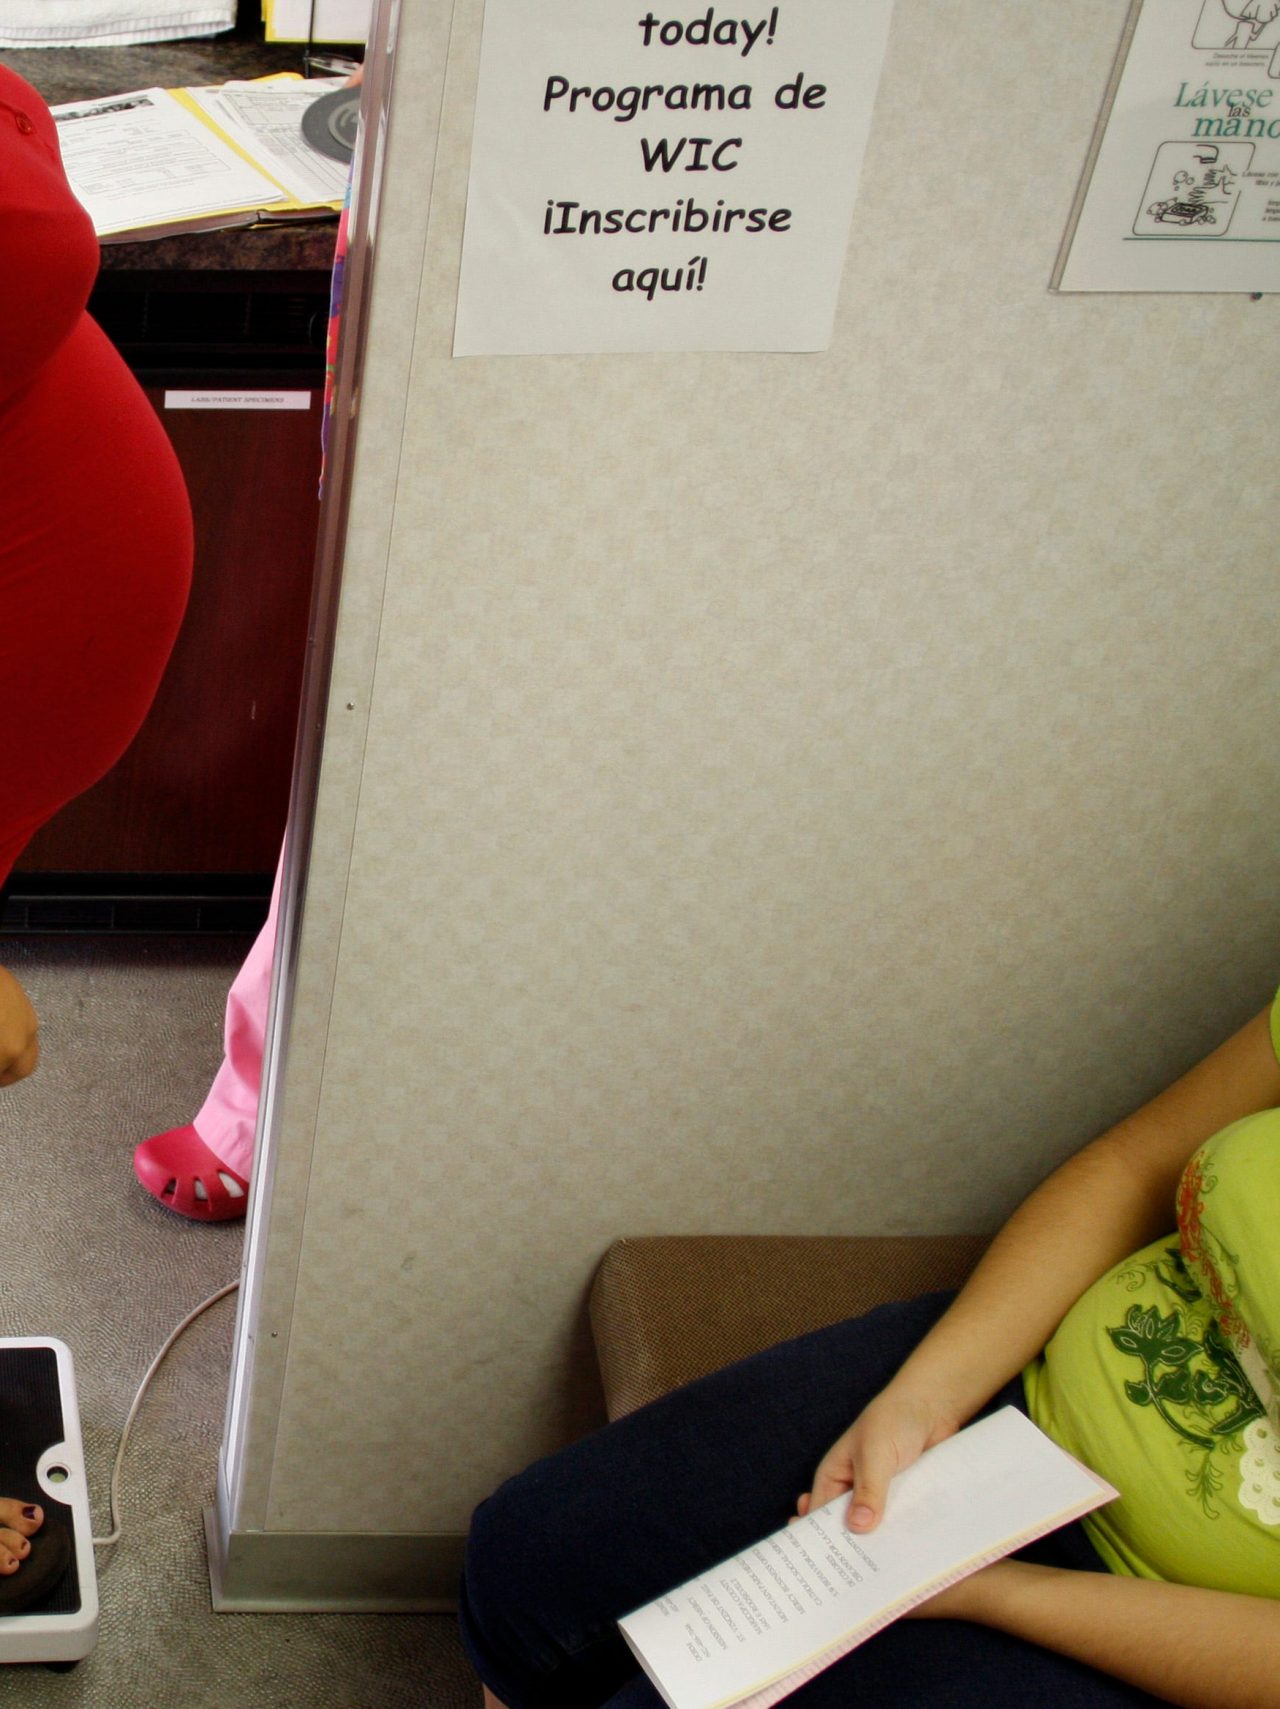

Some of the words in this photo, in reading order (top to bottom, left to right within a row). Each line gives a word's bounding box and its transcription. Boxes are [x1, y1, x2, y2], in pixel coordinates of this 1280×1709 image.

[639, 7, 778, 57] today!
[543, 75, 752, 122] Programa
[774, 72, 827, 109] de
[1174, 81, 1273, 108] Lávese
[1227, 103, 1251, 117] las
[641, 138, 742, 172] WIC
[612, 256, 708, 301] aquí!
